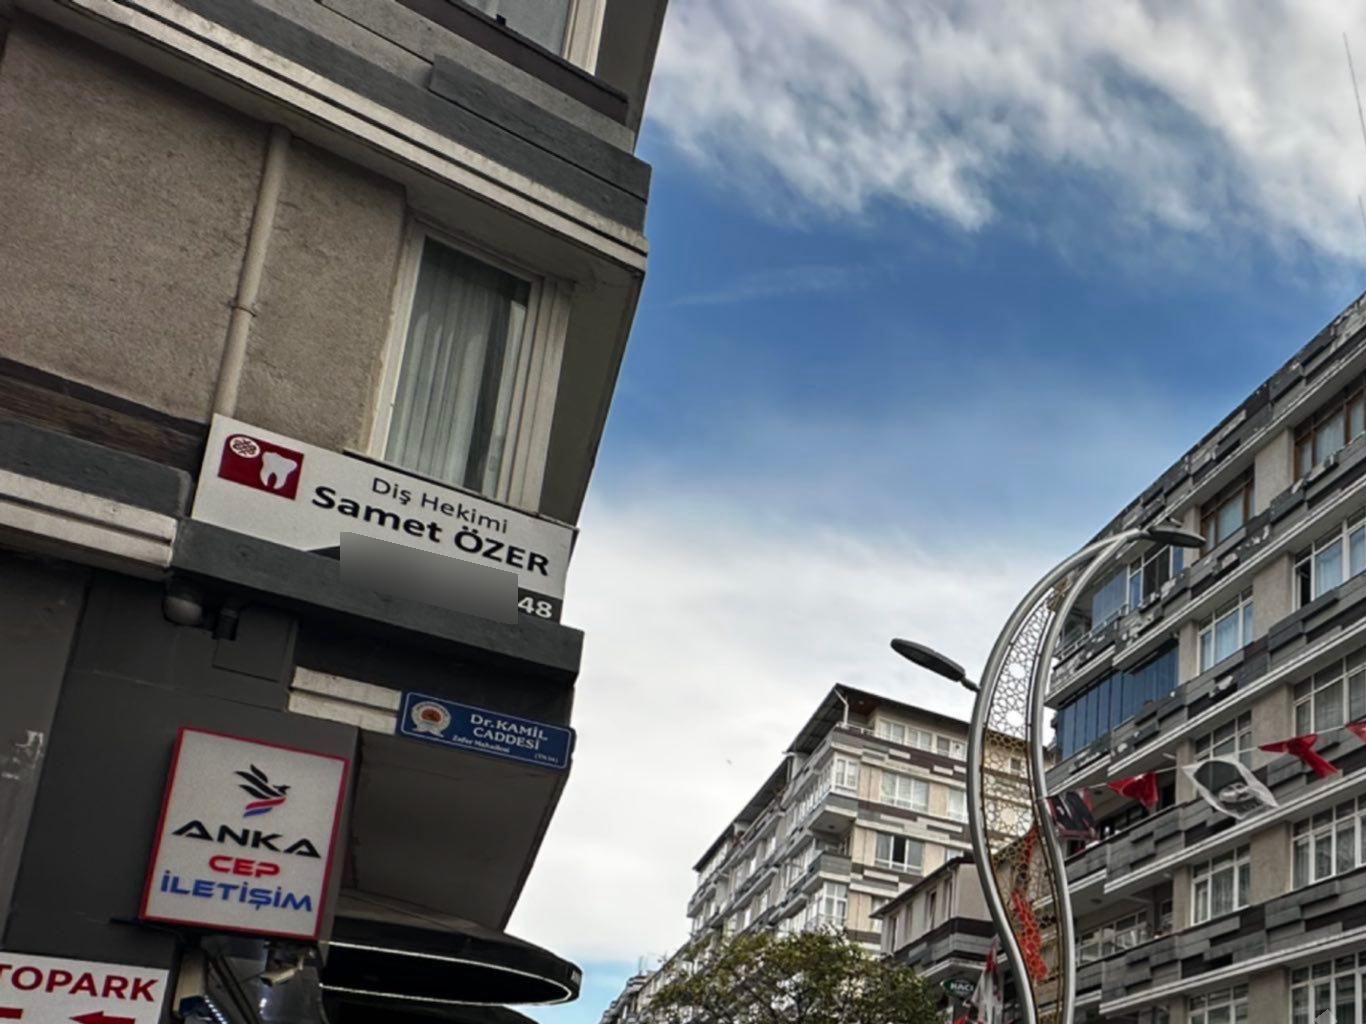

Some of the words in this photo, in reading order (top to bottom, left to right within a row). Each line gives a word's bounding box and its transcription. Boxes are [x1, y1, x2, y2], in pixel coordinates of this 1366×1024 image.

[372, 477, 411, 504] Diş
[421, 493, 508, 534] Hekimi
[312, 486, 442, 543] Samet
[454, 526, 549, 576] ÖZER
[470, 713, 548, 741] Dr.KAMİL
[473, 727, 540, 750] CADDESİ
[172, 820, 321, 858] ANKA
[209, 855, 280, 878] CEP
[160, 869, 313, 912] İLETİŞİM
